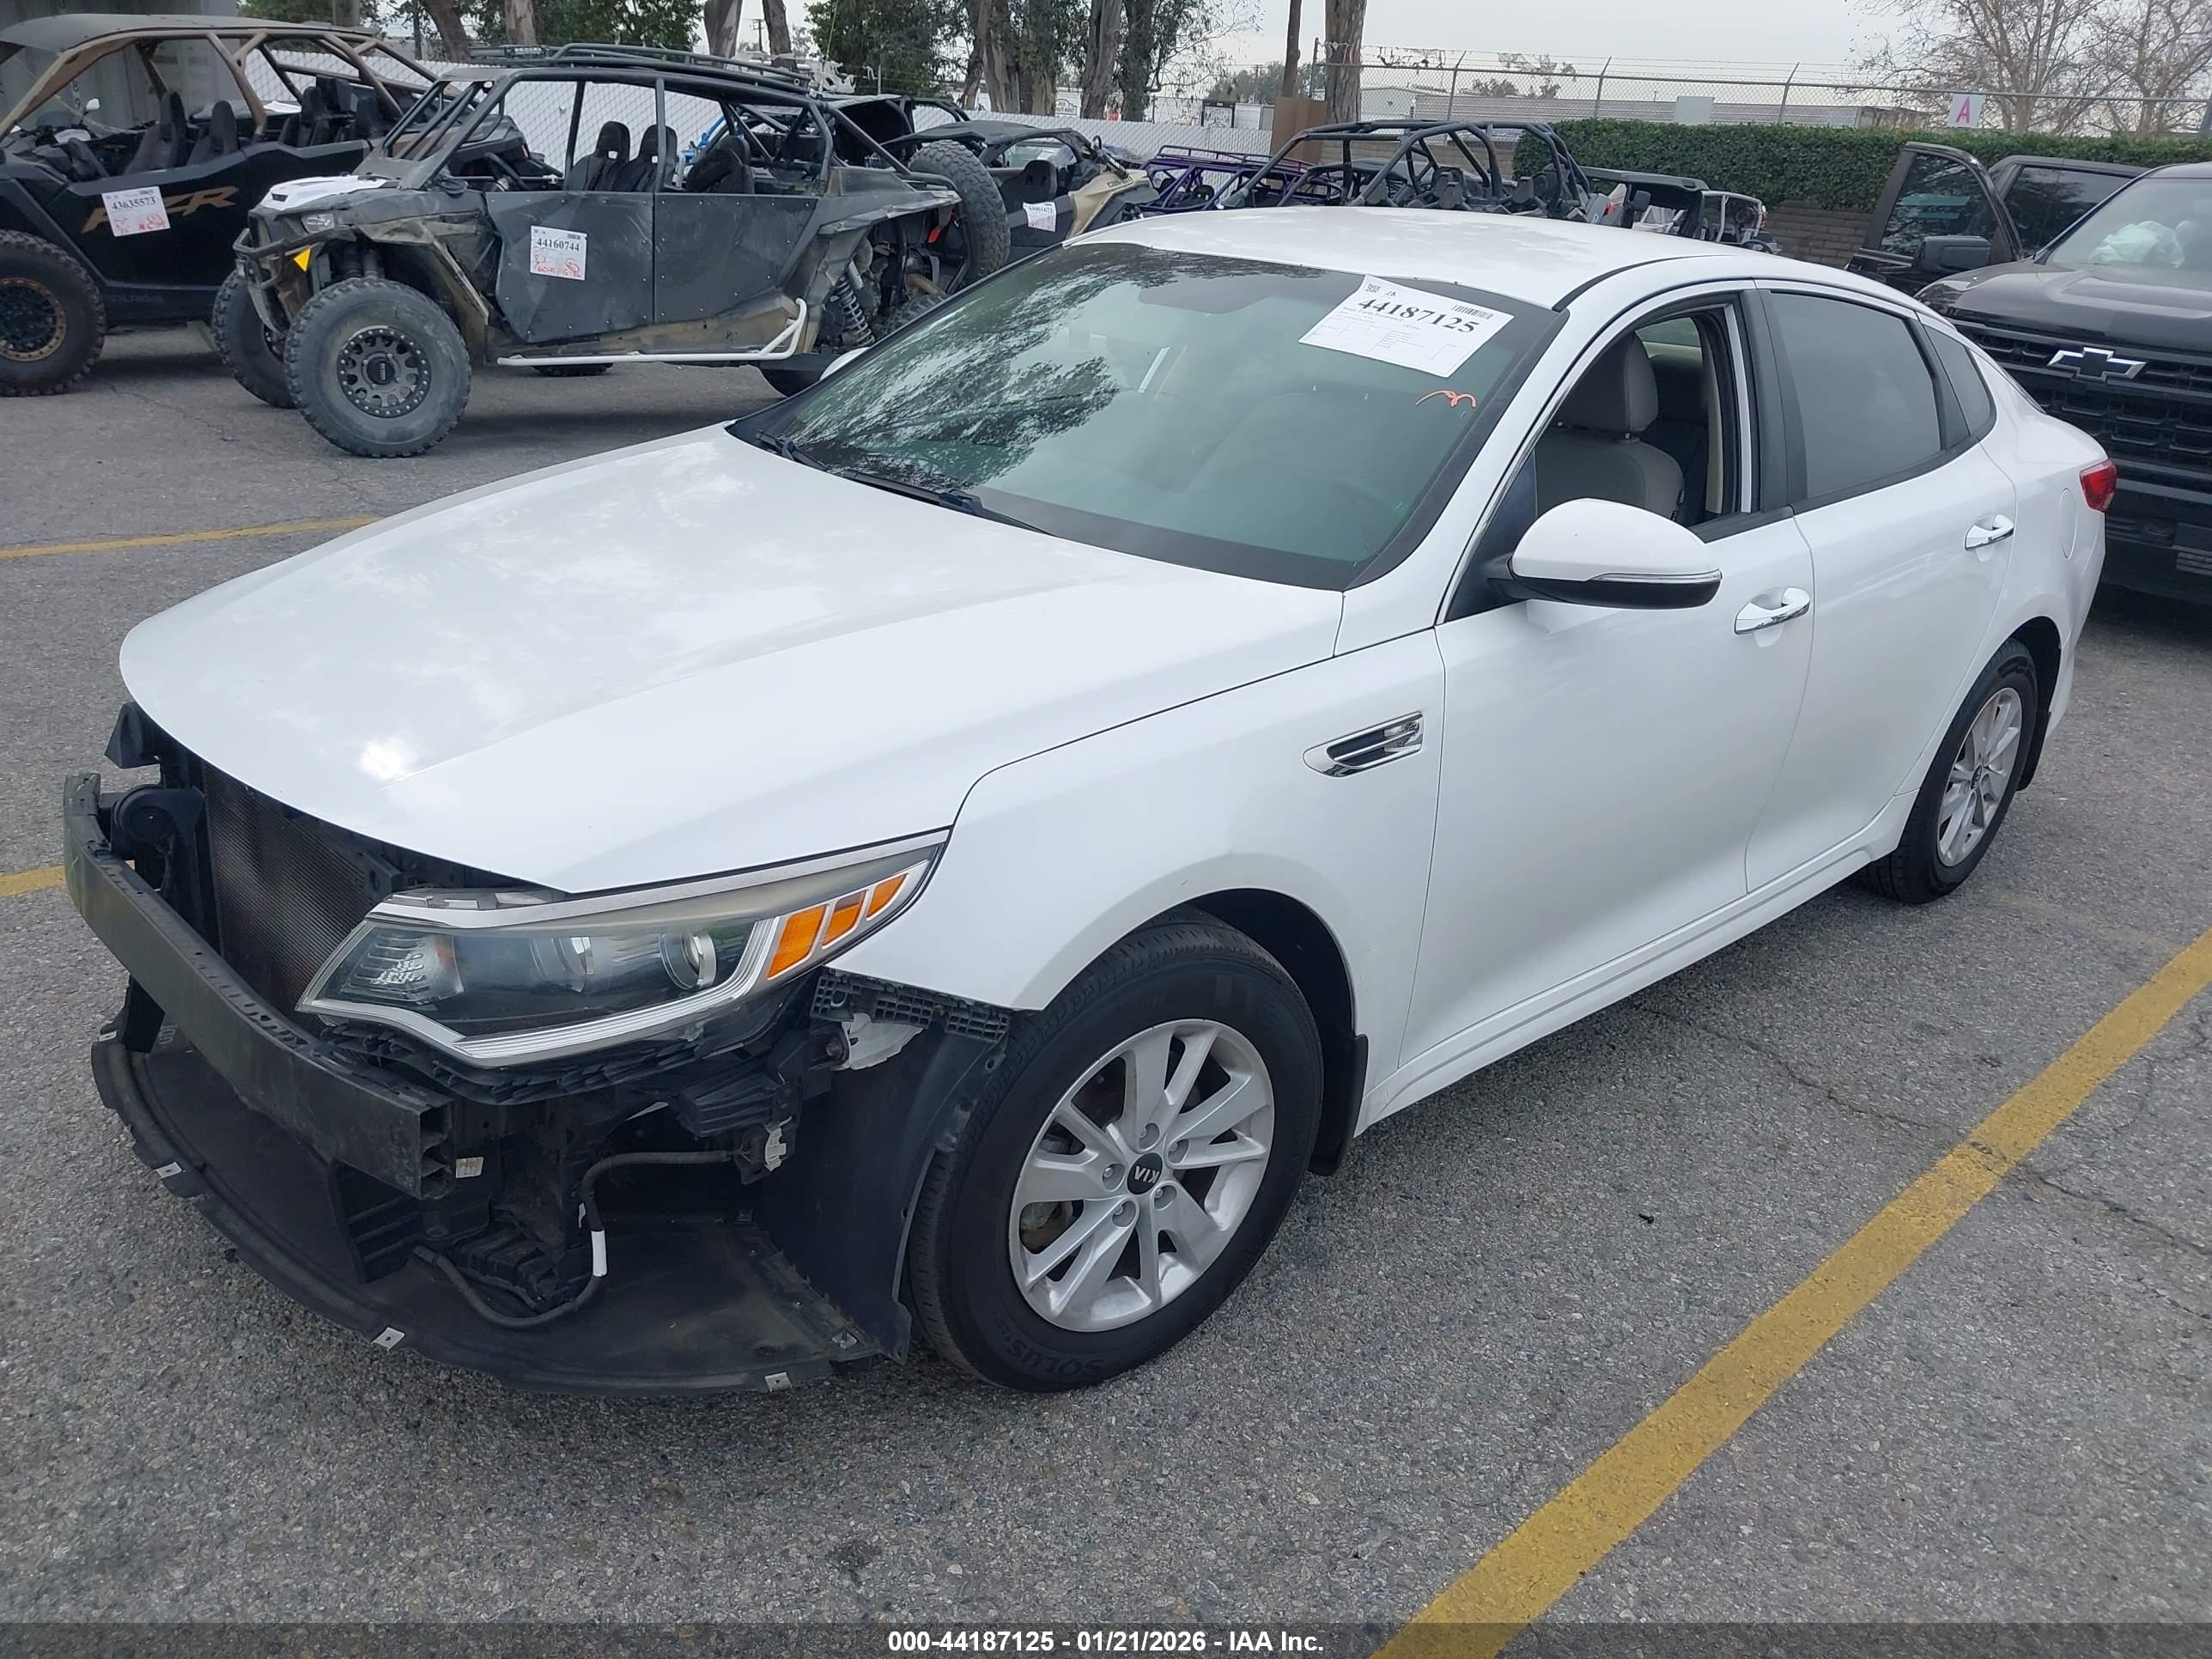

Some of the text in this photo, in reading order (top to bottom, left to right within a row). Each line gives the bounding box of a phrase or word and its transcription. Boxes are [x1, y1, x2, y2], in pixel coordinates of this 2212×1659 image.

[1955, 95, 1971, 124] A
[112, 196, 156, 211] 43635573
[537, 237, 580, 252] 44160744
[1357, 298, 1480, 333] 44187125
[1134, 1165, 1160, 1183] KIA
[1006, 1340, 1103, 1375] SOLUS
